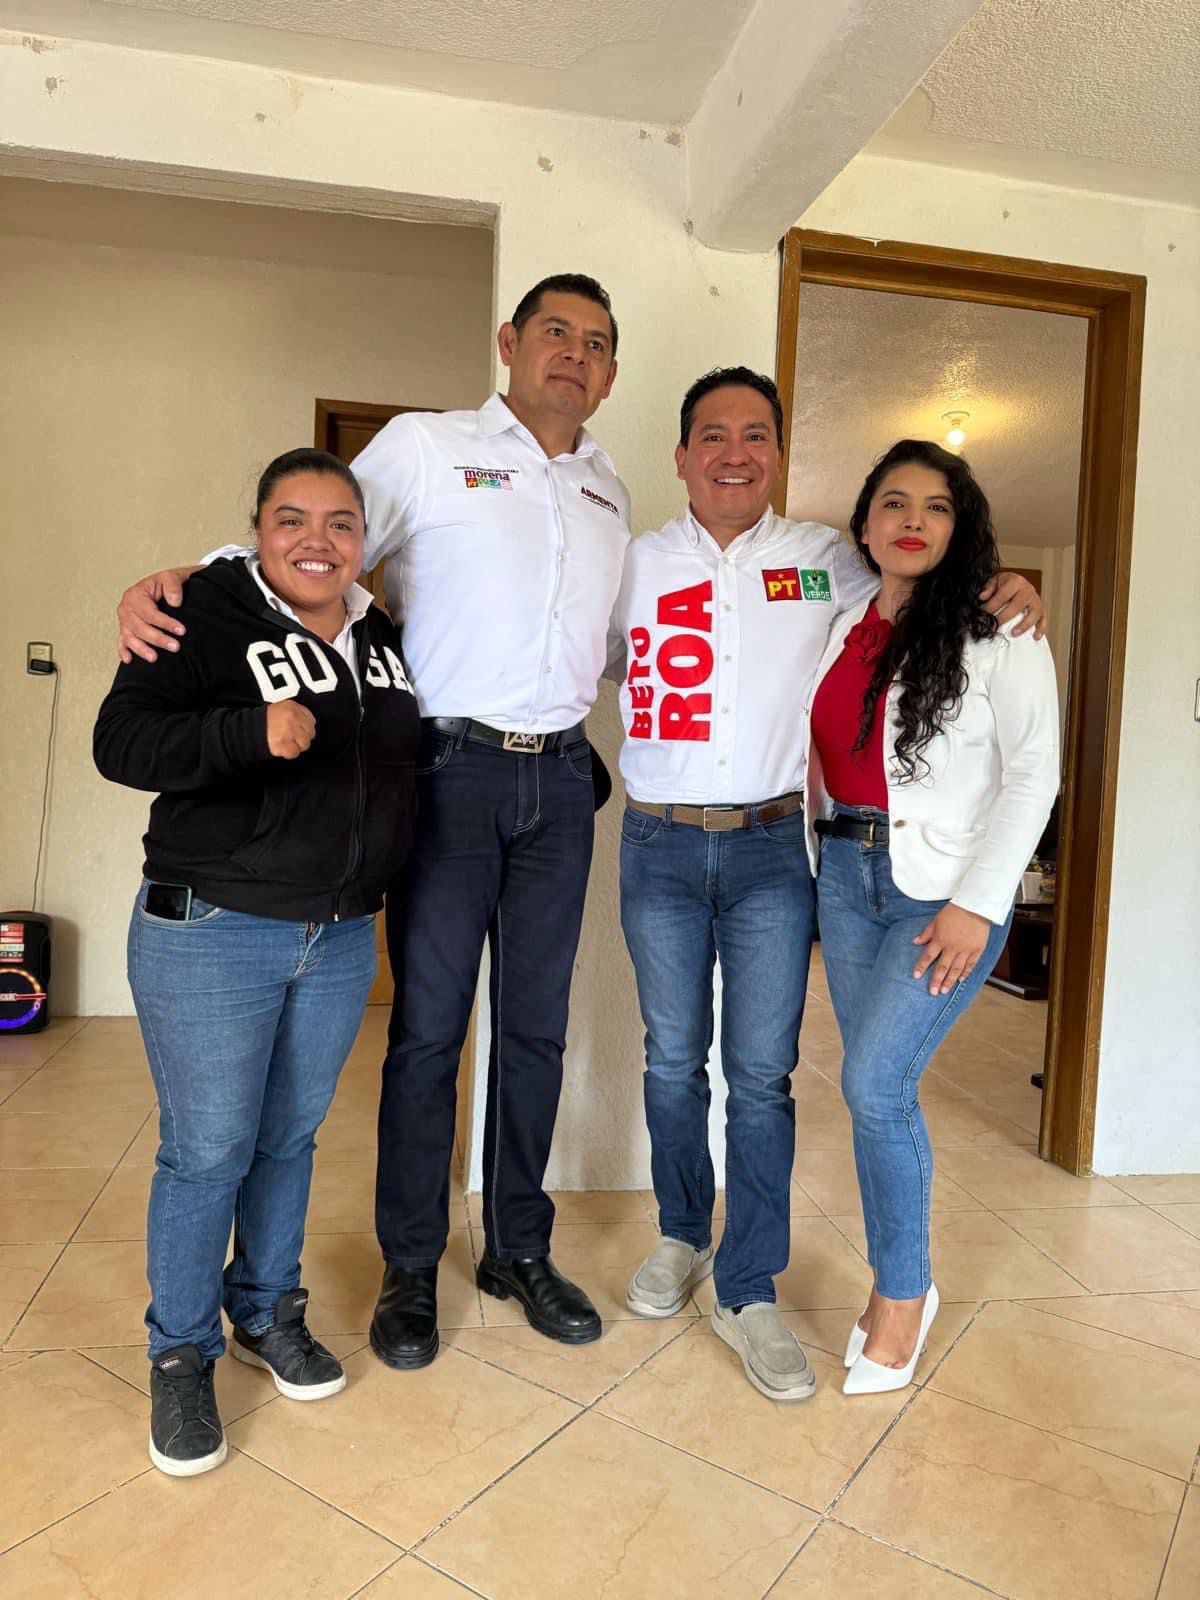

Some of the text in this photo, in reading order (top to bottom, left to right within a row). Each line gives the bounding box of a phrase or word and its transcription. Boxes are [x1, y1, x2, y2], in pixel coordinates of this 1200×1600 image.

[464, 470, 510, 481] morena
[581, 486, 619, 513] ARMENTA
[768, 579, 796, 597] PT
[805, 590, 831, 600] VERDE
[246, 632, 338, 704] GO
[656, 579, 714, 742] ROA
[628, 626, 655, 740] BETO
